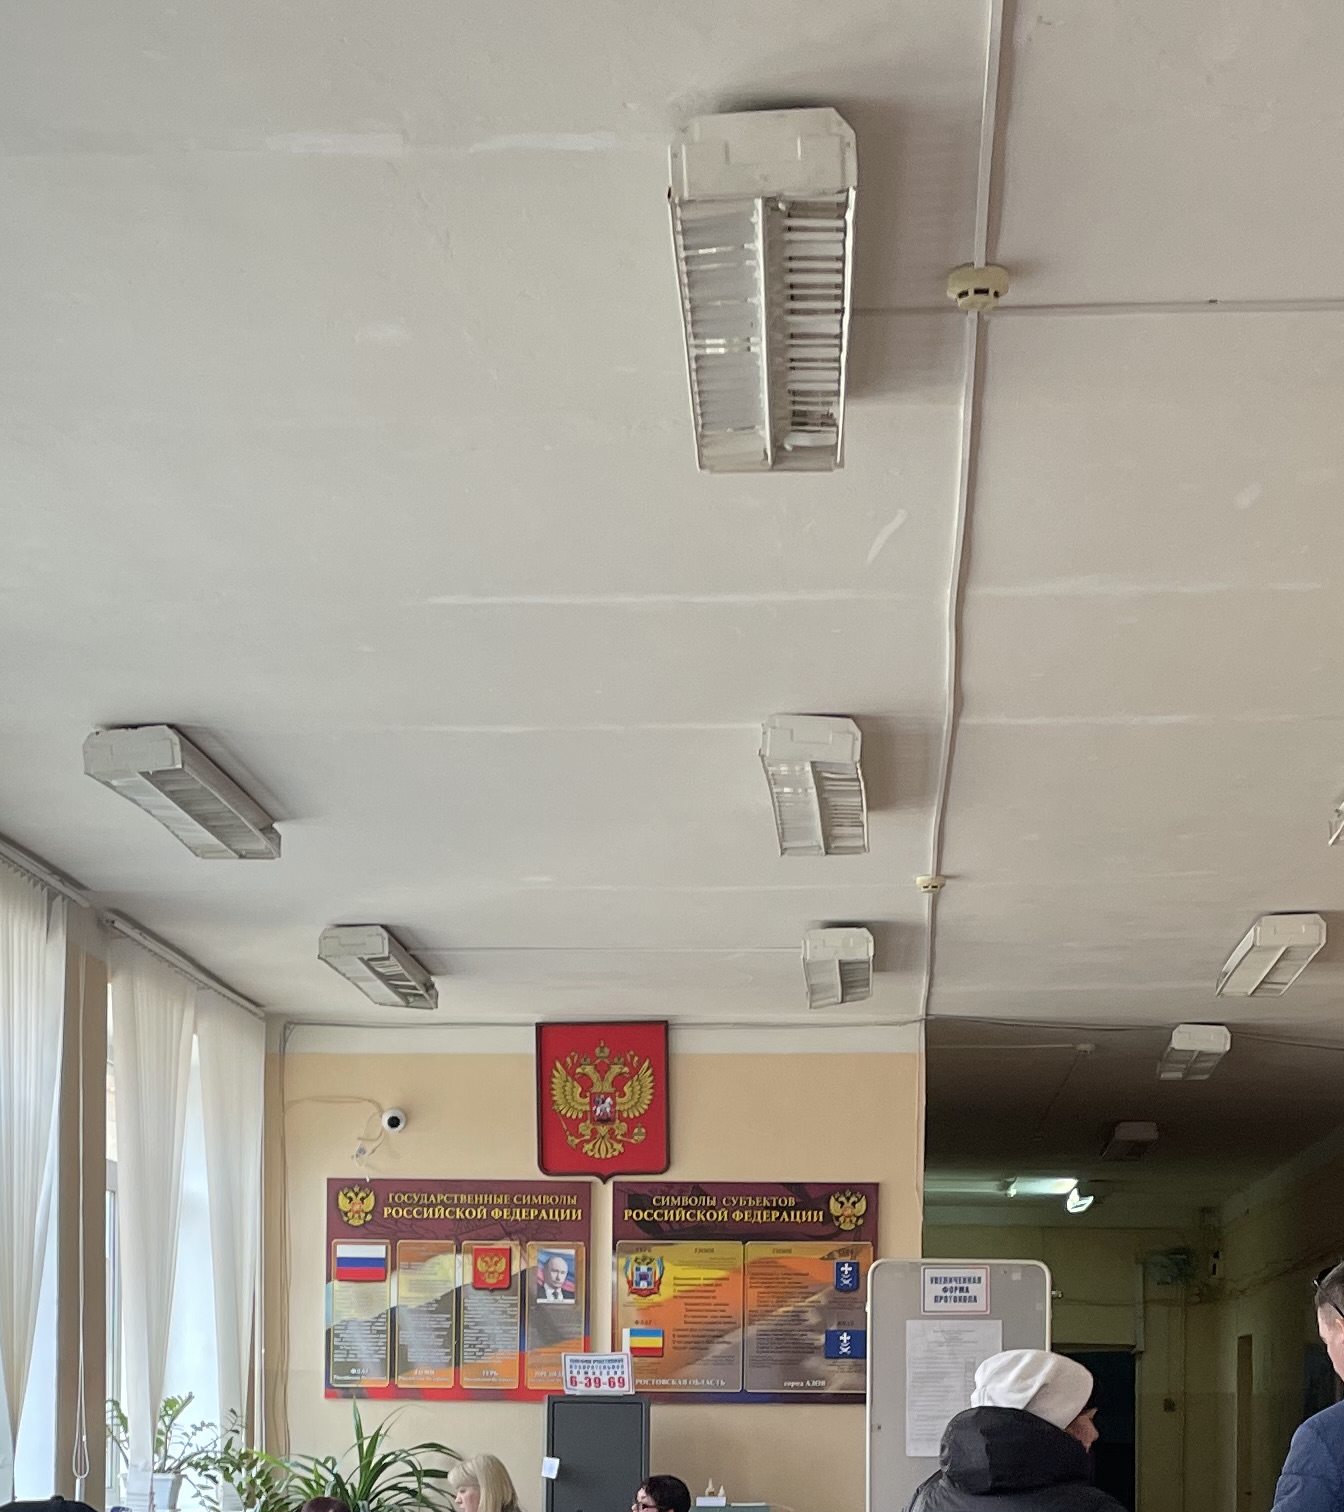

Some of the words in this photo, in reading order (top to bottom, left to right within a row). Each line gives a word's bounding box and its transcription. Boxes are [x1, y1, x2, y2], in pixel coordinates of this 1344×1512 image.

[388, 1192, 512, 1205] ГОСУДАРСТВЕННЫЕ
[513, 1194, 578, 1206] СИМВОЛЫ
[652, 1195, 717, 1207] СИМВОЛЫ
[722, 1195, 796, 1207] СУБЪЕКТОВ
[383, 1204, 488, 1220] РОССИЙСКОЙ
[490, 1207, 583, 1222] ФЕДЕРАЦИИ
[623, 1207, 728, 1222] РОССИЙСКОЙ
[731, 1209, 824, 1224] ФЕДЕРАЦИИ
[942, 1286, 970, 1294] ФОРМА
[934, 1295, 978, 1304] ПРОТОКОЛА
[570, 1375, 625, 1389] 6-39-69
